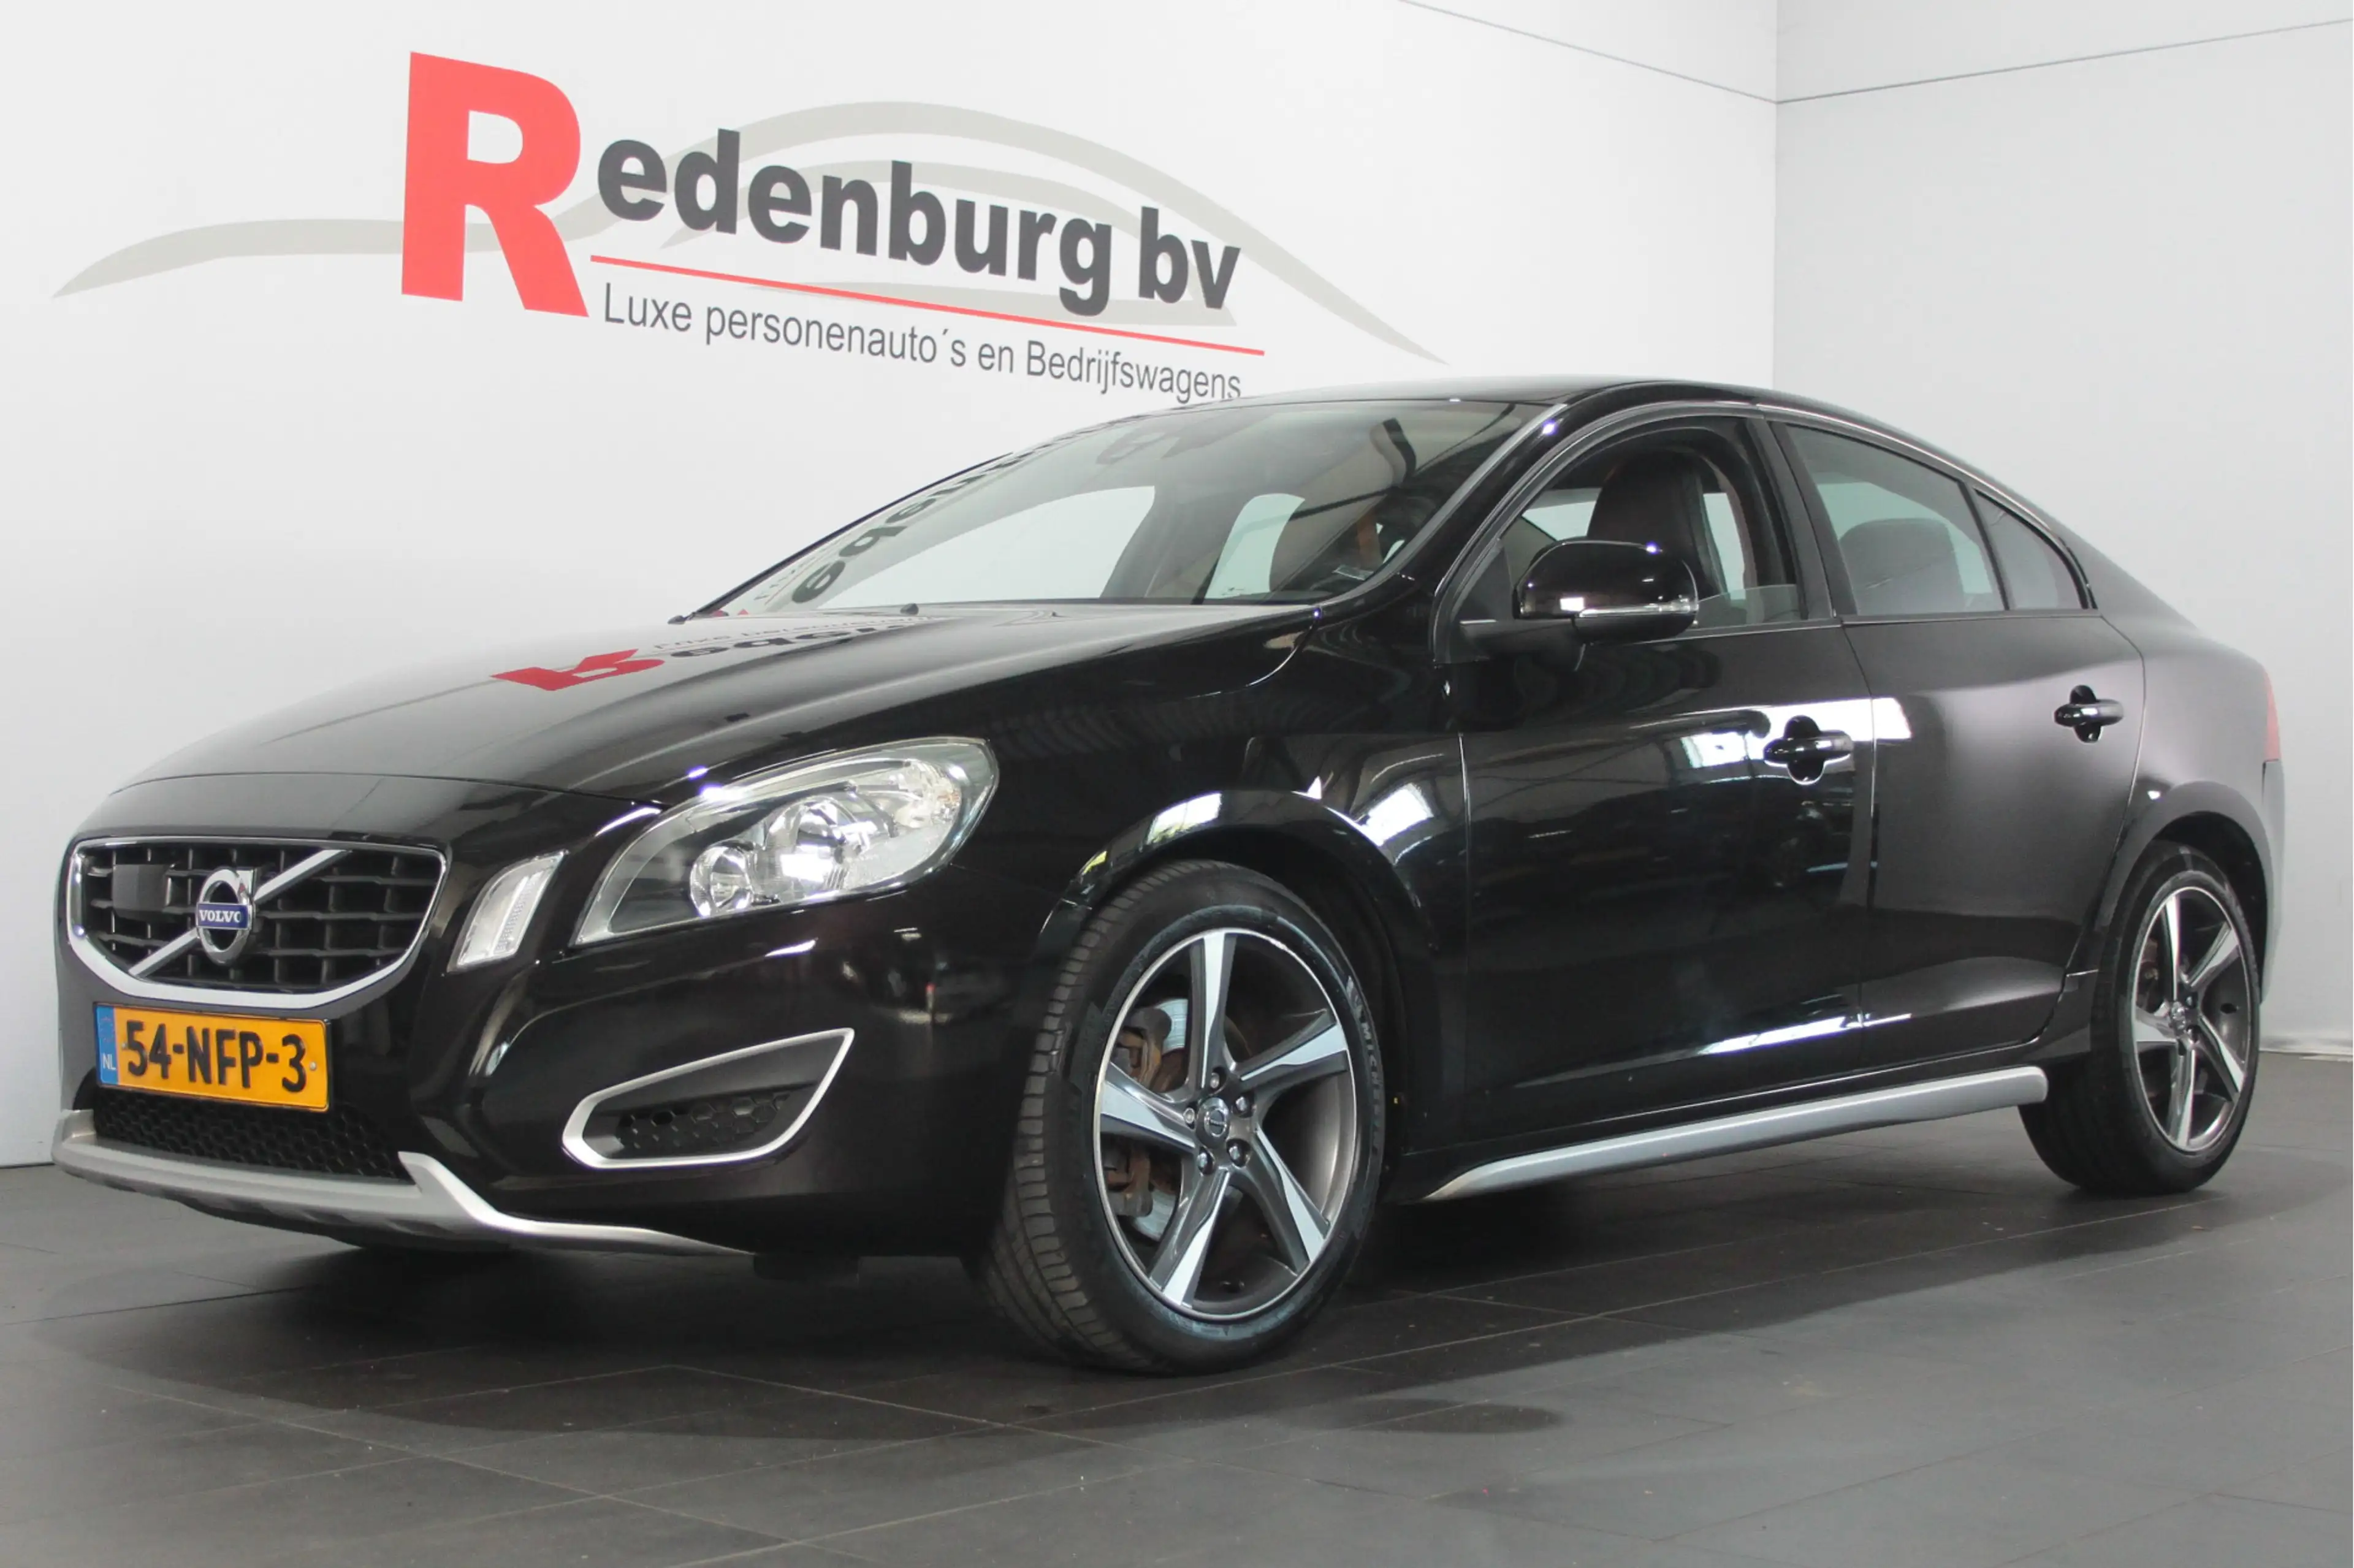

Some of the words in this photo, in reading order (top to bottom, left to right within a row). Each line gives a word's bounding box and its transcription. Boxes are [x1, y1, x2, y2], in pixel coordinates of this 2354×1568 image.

[401, 50, 1113, 318] Redenburg
[1138, 206, 1242, 310] bv
[604, 282, 692, 332] Luxe
[978, 343, 1014, 373] en
[1026, 340, 1242, 405] Bedrijfswagens
[198, 909, 242, 923] VOLVO
[102, 1052, 116, 1070] NL
[126, 1021, 307, 1092] 54-NFP-3
